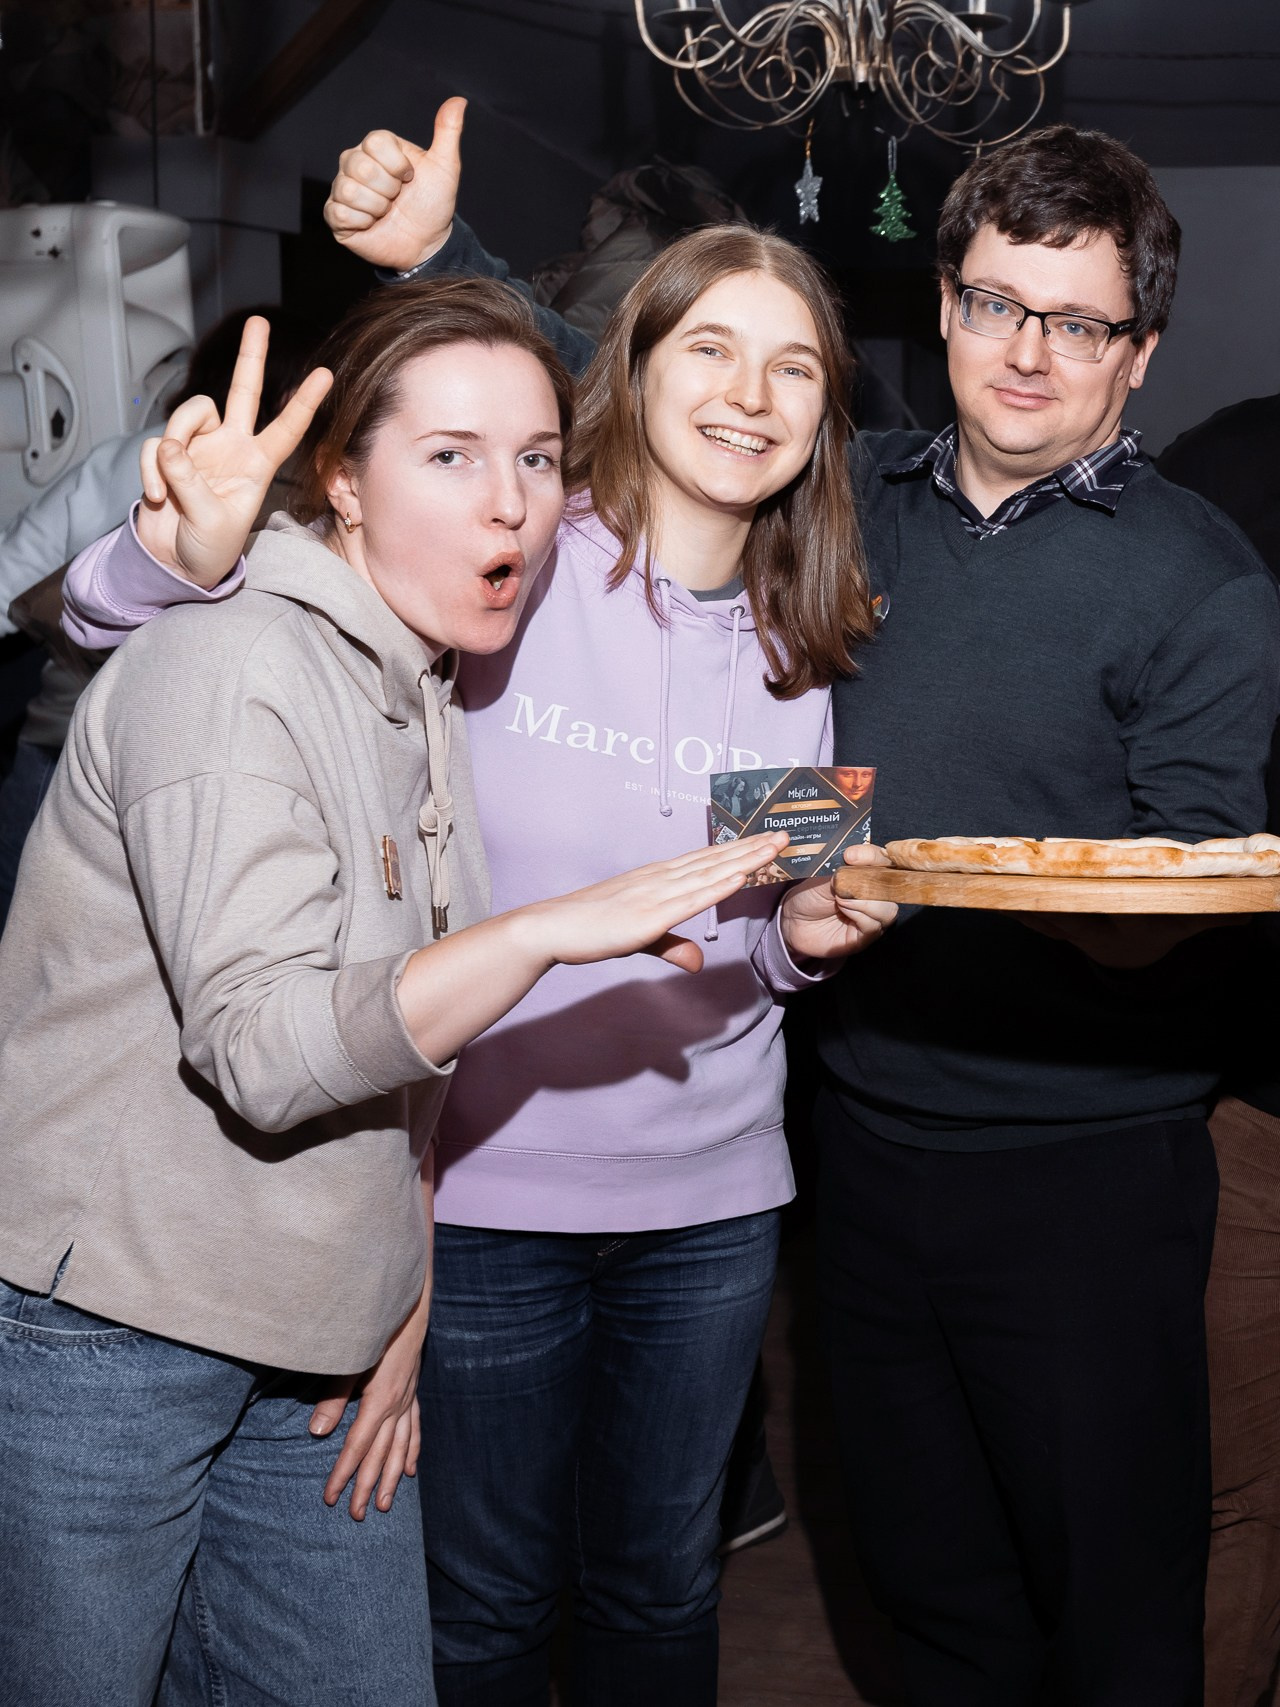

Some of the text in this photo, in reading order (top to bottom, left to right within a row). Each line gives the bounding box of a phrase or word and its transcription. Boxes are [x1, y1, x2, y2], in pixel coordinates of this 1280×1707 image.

[504, 692, 800, 776] Marc O'P
[650, 786, 662, 796] IN
[764, 811, 840, 829] Подарочный
[796, 823, 839, 833] сертификат
[788, 832, 822, 842] лайн-игры
